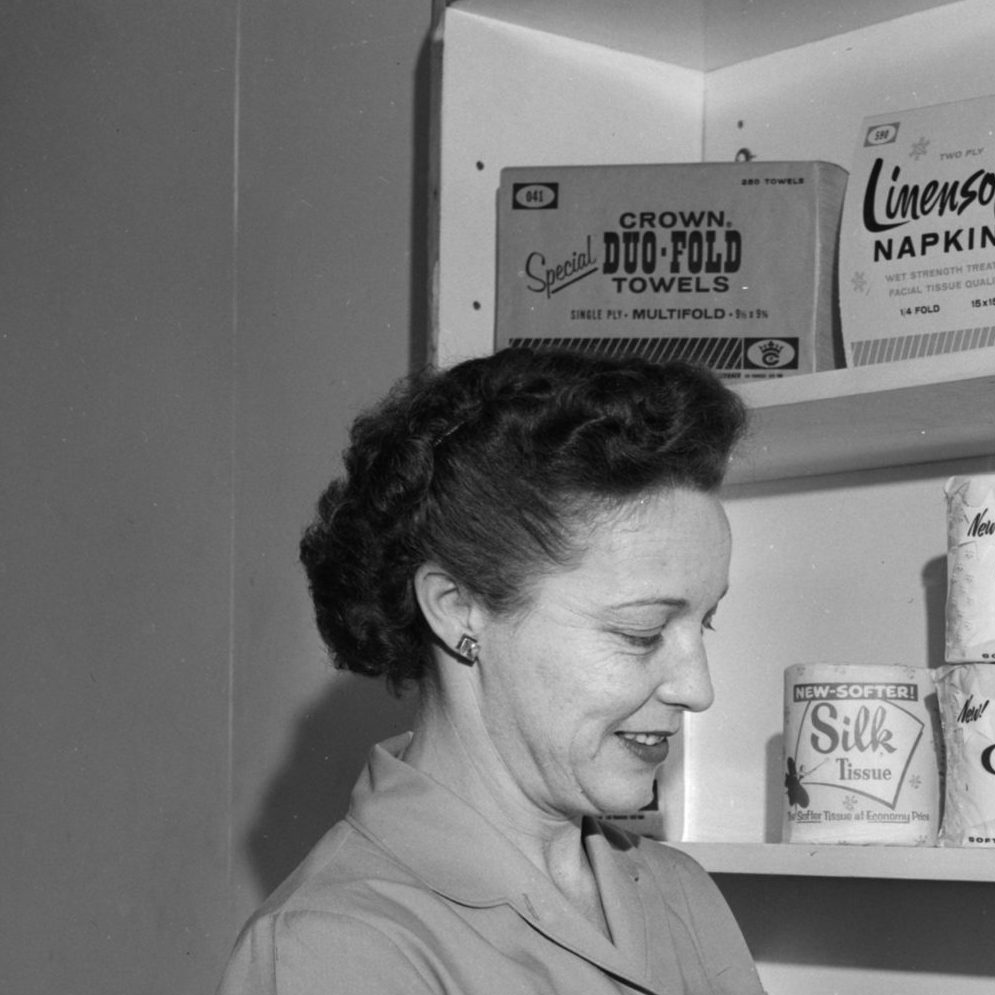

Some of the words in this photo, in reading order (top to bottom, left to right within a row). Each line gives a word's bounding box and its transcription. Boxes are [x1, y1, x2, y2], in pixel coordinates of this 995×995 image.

[939, 150, 962, 161] TWO
[964, 147, 985, 158] PLY
[764, 177, 804, 186] TOWELS
[619, 211, 725, 229] CROWN
[525, 235, 597, 299] Special
[885, 271, 908, 283] WET
[910, 265, 963, 281] STRENGTH
[612, 275, 730, 294] TOWELS
[889, 285, 923, 297] FACIAL
[926, 280, 962, 294] TISSUE
[570, 309, 602, 321] SINGLE
[606, 309, 623, 321] PLY
[632, 308, 726, 320] MULTIFOLD
[914, 304, 940, 316] FOLD
[957, 695, 989, 723] New!
[810, 702, 898, 754] Silk
[835, 758, 892, 781] Tissue
[823, 810, 852, 821] Tissue
[866, 810, 910, 823] Economy
